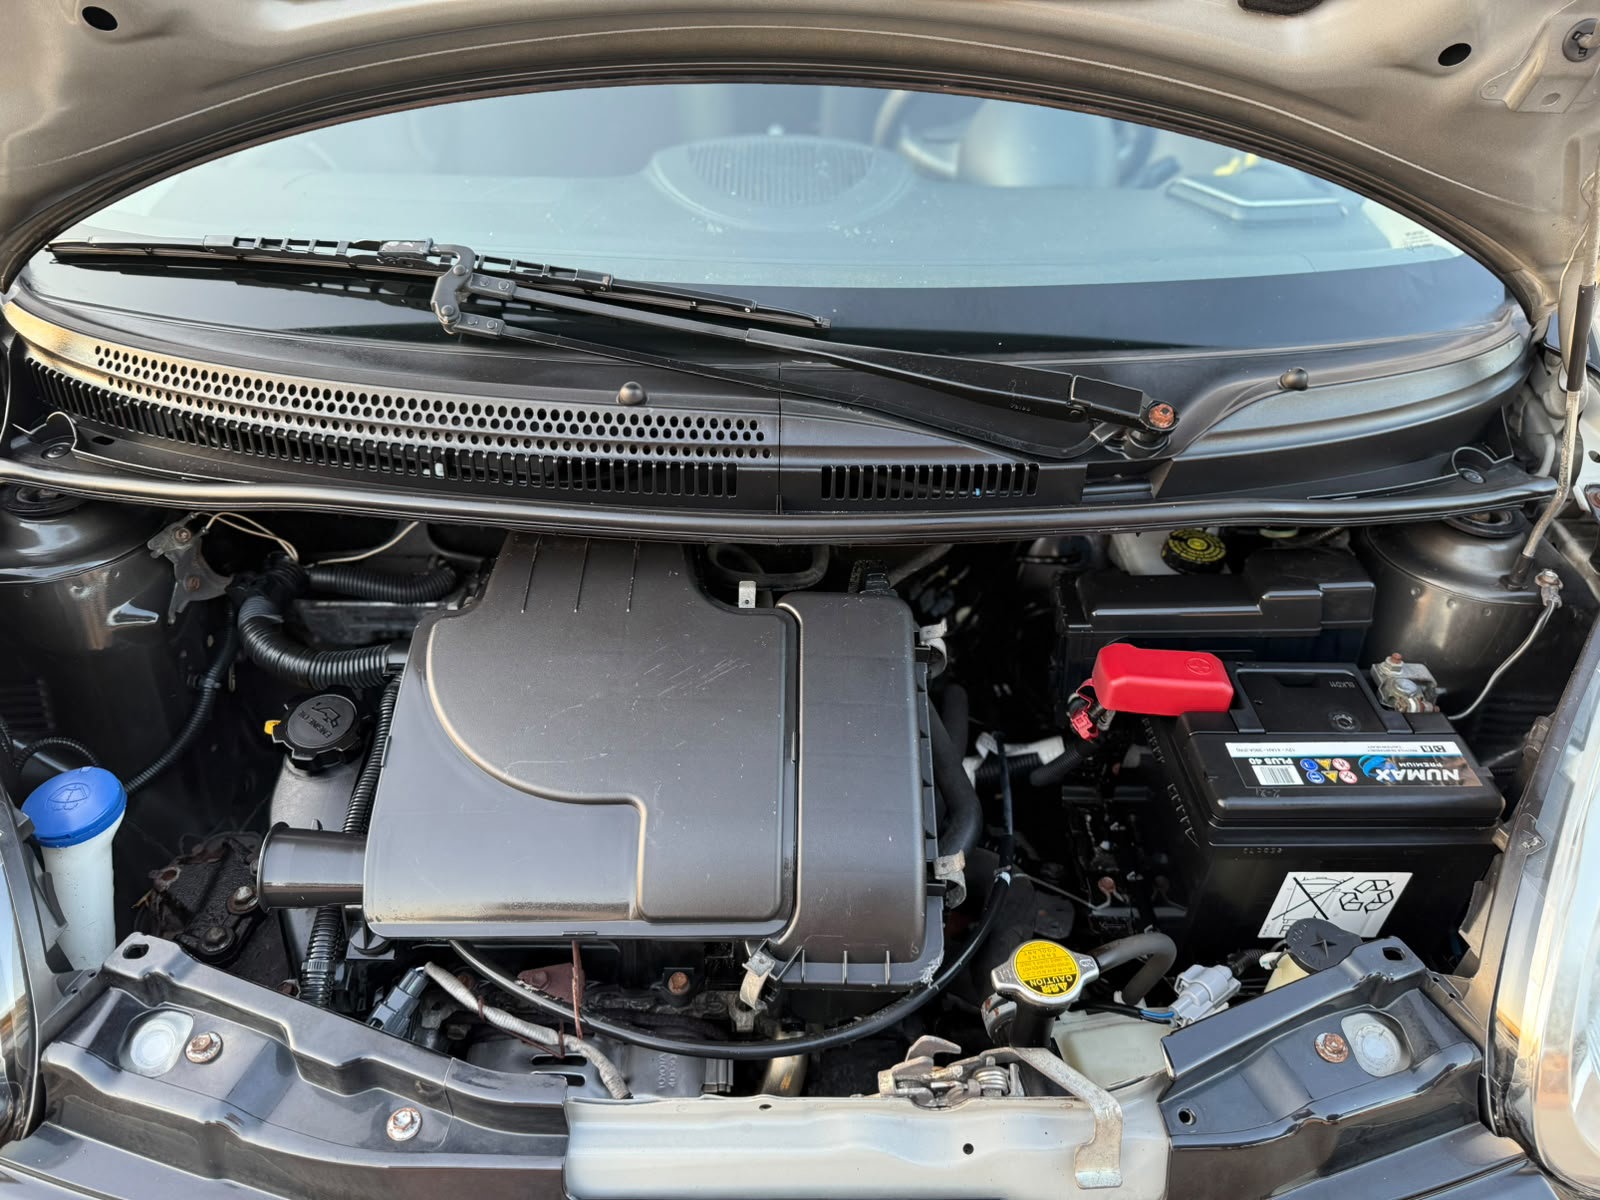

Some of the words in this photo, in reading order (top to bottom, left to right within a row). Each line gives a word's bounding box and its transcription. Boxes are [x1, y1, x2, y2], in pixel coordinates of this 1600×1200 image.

[308, 717, 333, 739] ENGINE
[1375, 769, 1460, 781] NUMAX
[1029, 975, 1073, 987] CAUTION
